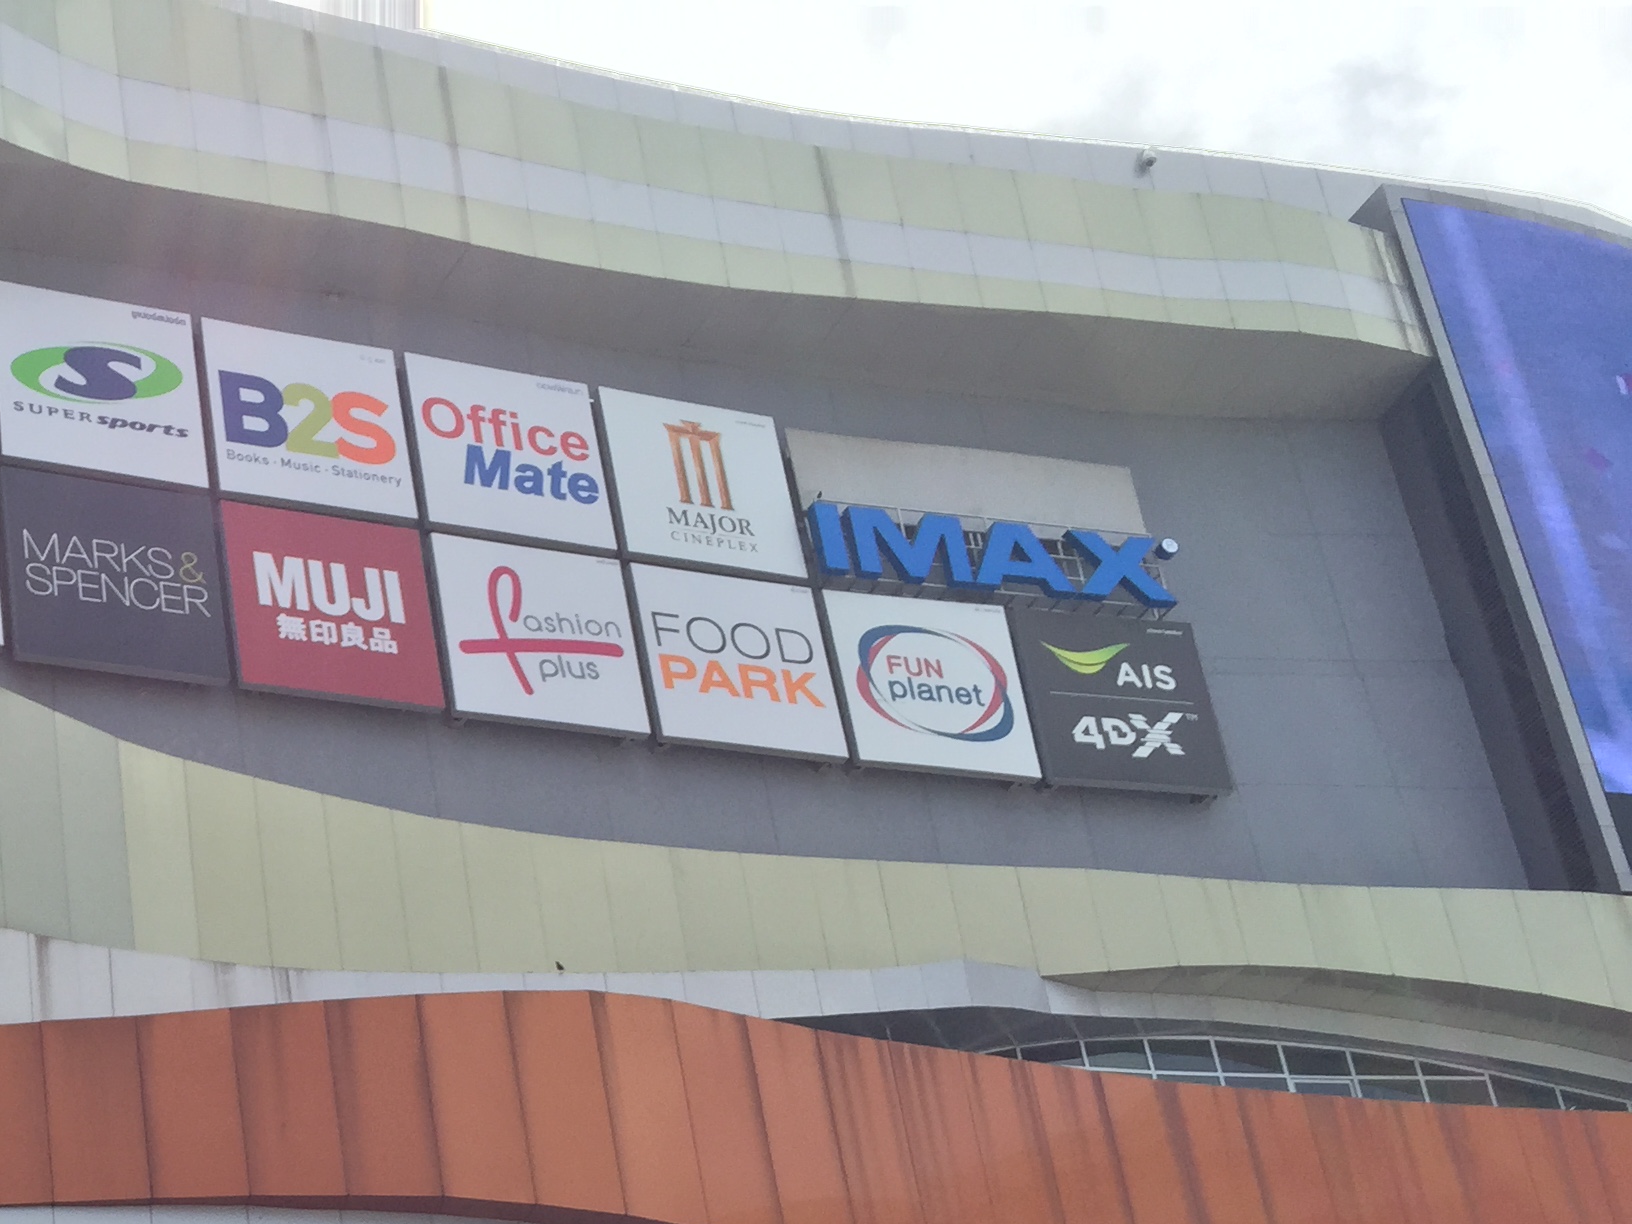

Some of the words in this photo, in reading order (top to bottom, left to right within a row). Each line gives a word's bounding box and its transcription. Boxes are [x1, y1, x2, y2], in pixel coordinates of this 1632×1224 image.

[217, 369, 397, 467] B2S
[421, 396, 591, 462] Office
[226, 448, 270, 467] Books
[280, 458, 322, 474] Music
[331, 464, 404, 488] Stationery
[463, 443, 600, 505] Mate
[665, 505, 756, 538] MAJOR
[669, 529, 760, 554] CINEPLEX
[807, 499, 1178, 609] IMAX
[24, 562, 213, 619] SPENCER
[252, 550, 407, 625] MUJI
[275, 612, 399, 656] 無印良品
[651, 610, 814, 665] FOOD
[538, 654, 601, 682] plus
[658, 653, 827, 709] PARK
[885, 653, 945, 679] FUN
[1116, 661, 1177, 691] AIS
[888, 676, 986, 708] planet
